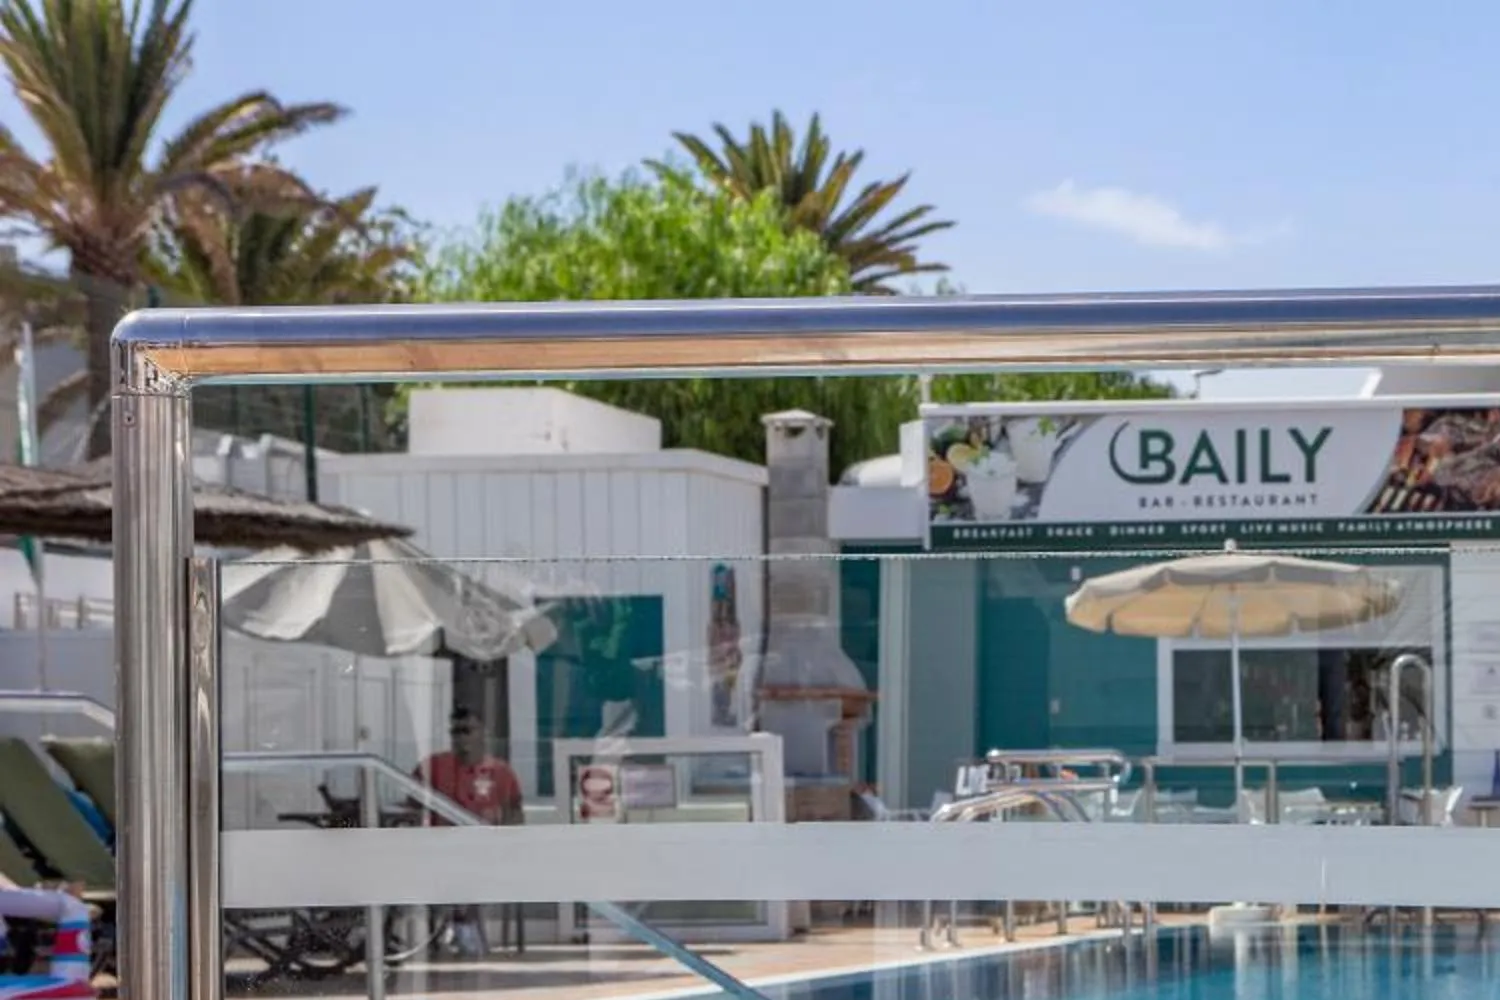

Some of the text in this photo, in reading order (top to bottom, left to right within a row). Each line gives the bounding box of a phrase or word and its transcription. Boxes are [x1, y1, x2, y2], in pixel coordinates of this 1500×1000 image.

[1110, 420, 1333, 485] BAILY
[1138, 495, 1174, 508] BAR
[1193, 493, 1318, 508] RESTAURANT
[952, 527, 1034, 539] BREAKFAST
[1109, 524, 1166, 536] DINNER
[1180, 523, 1227, 534] SPORT
[1240, 523, 1273, 534] LIVE
[1277, 522, 1325, 533] MUSIC
[1337, 521, 1391, 532] FAMILY
[1396, 519, 1493, 531] ATMOSPHERE
